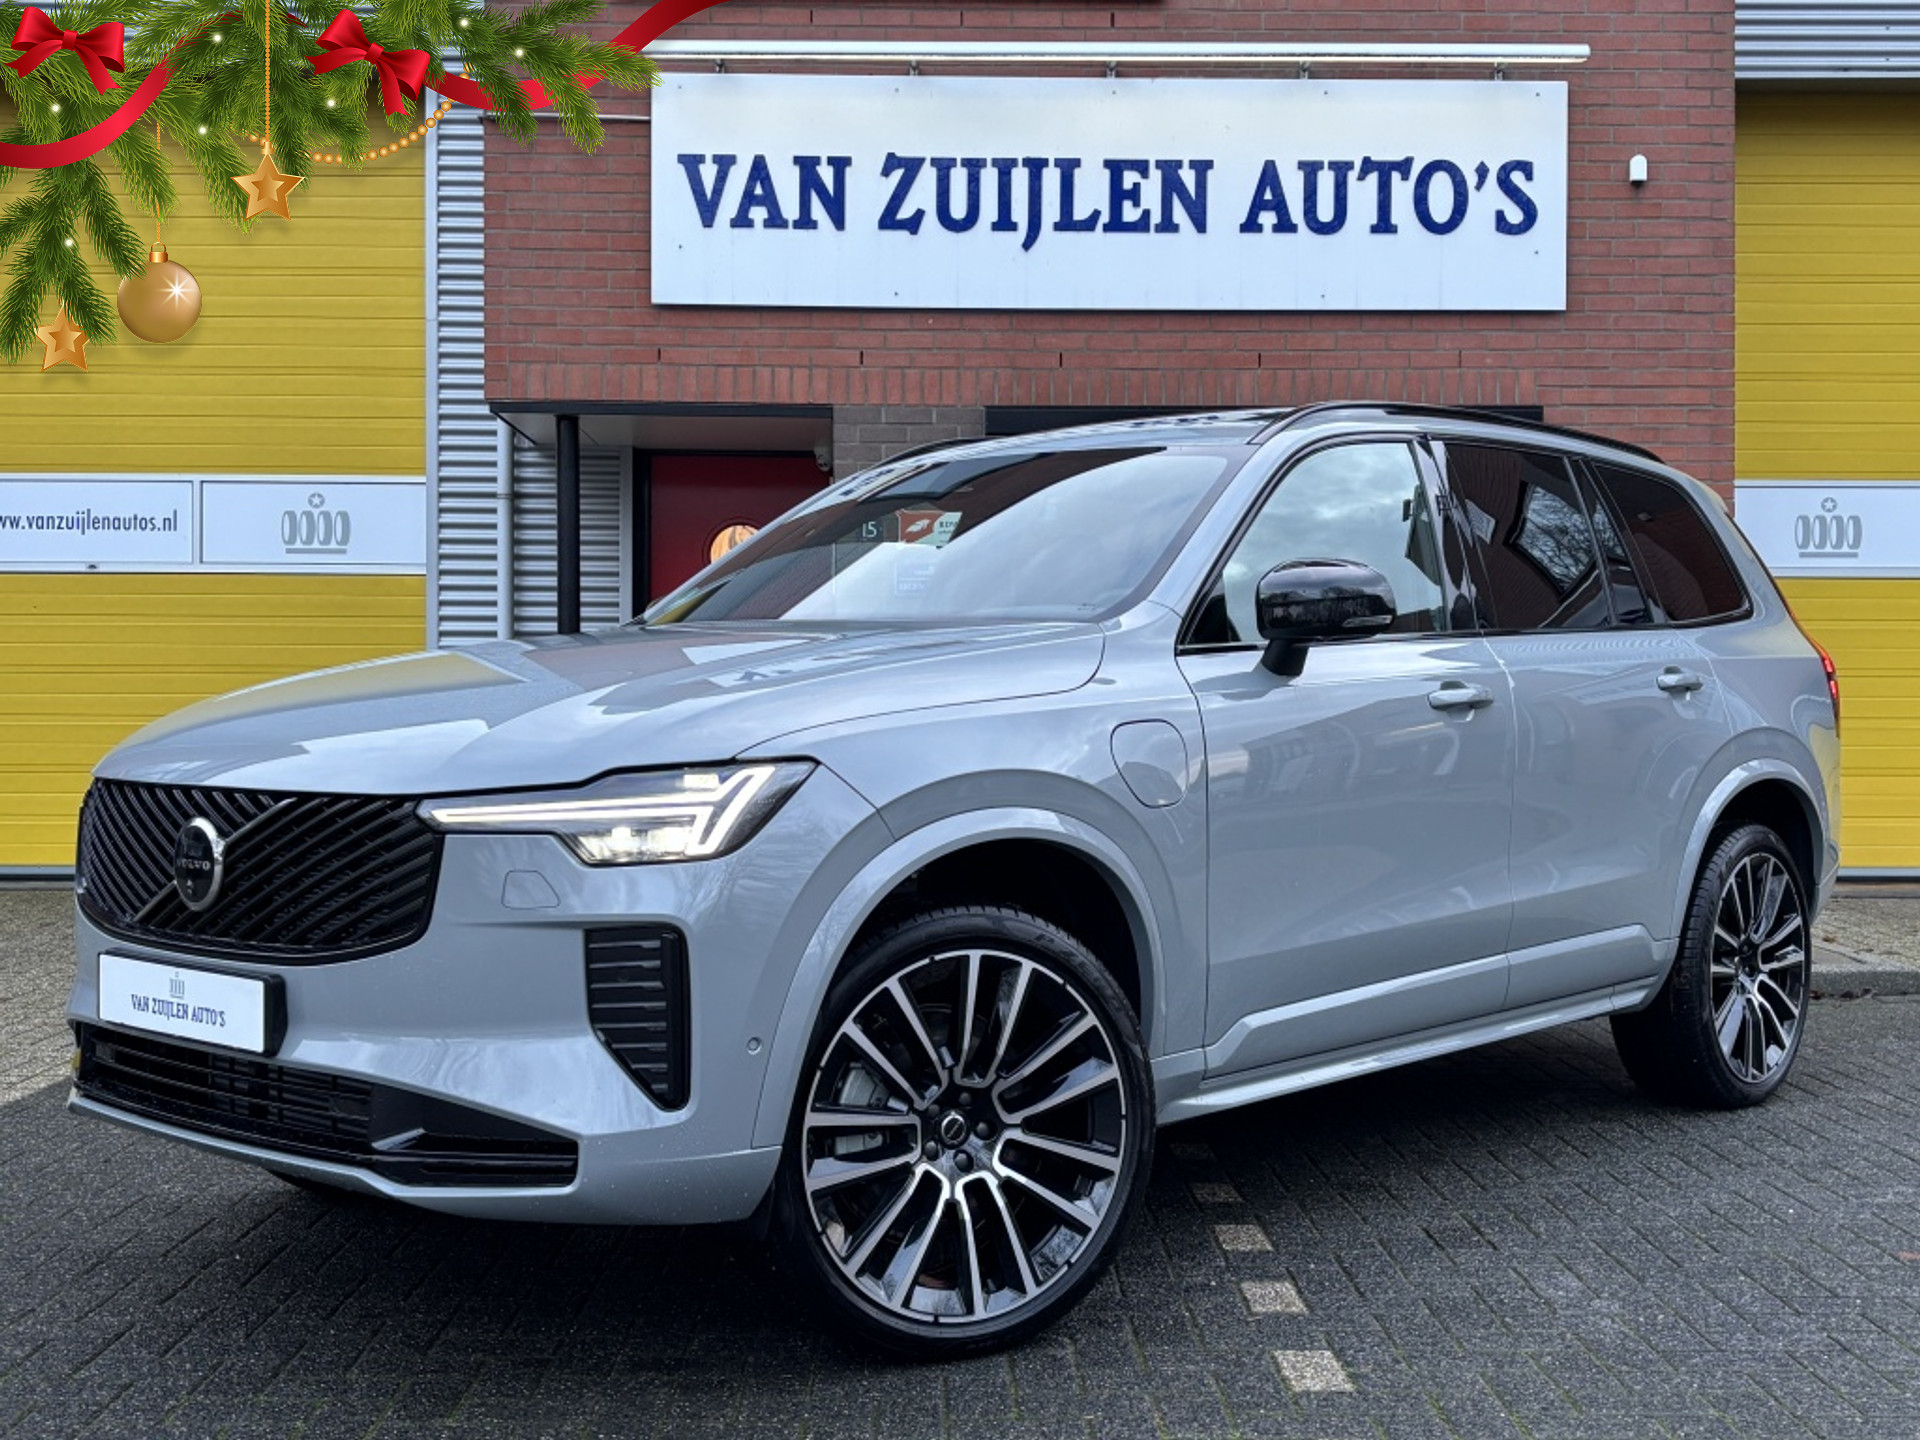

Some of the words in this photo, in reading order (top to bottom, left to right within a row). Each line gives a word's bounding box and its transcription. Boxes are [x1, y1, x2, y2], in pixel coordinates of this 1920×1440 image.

[677, 153, 851, 231] VAN
[876, 151, 1214, 251] ZUIJLEN
[1238, 156, 1537, 235] AUTO'S
[131, 993, 150, 1012] VAN
[151, 997, 189, 1020] ZUIJLEN
[190, 1005, 226, 1027] AUTO'S
